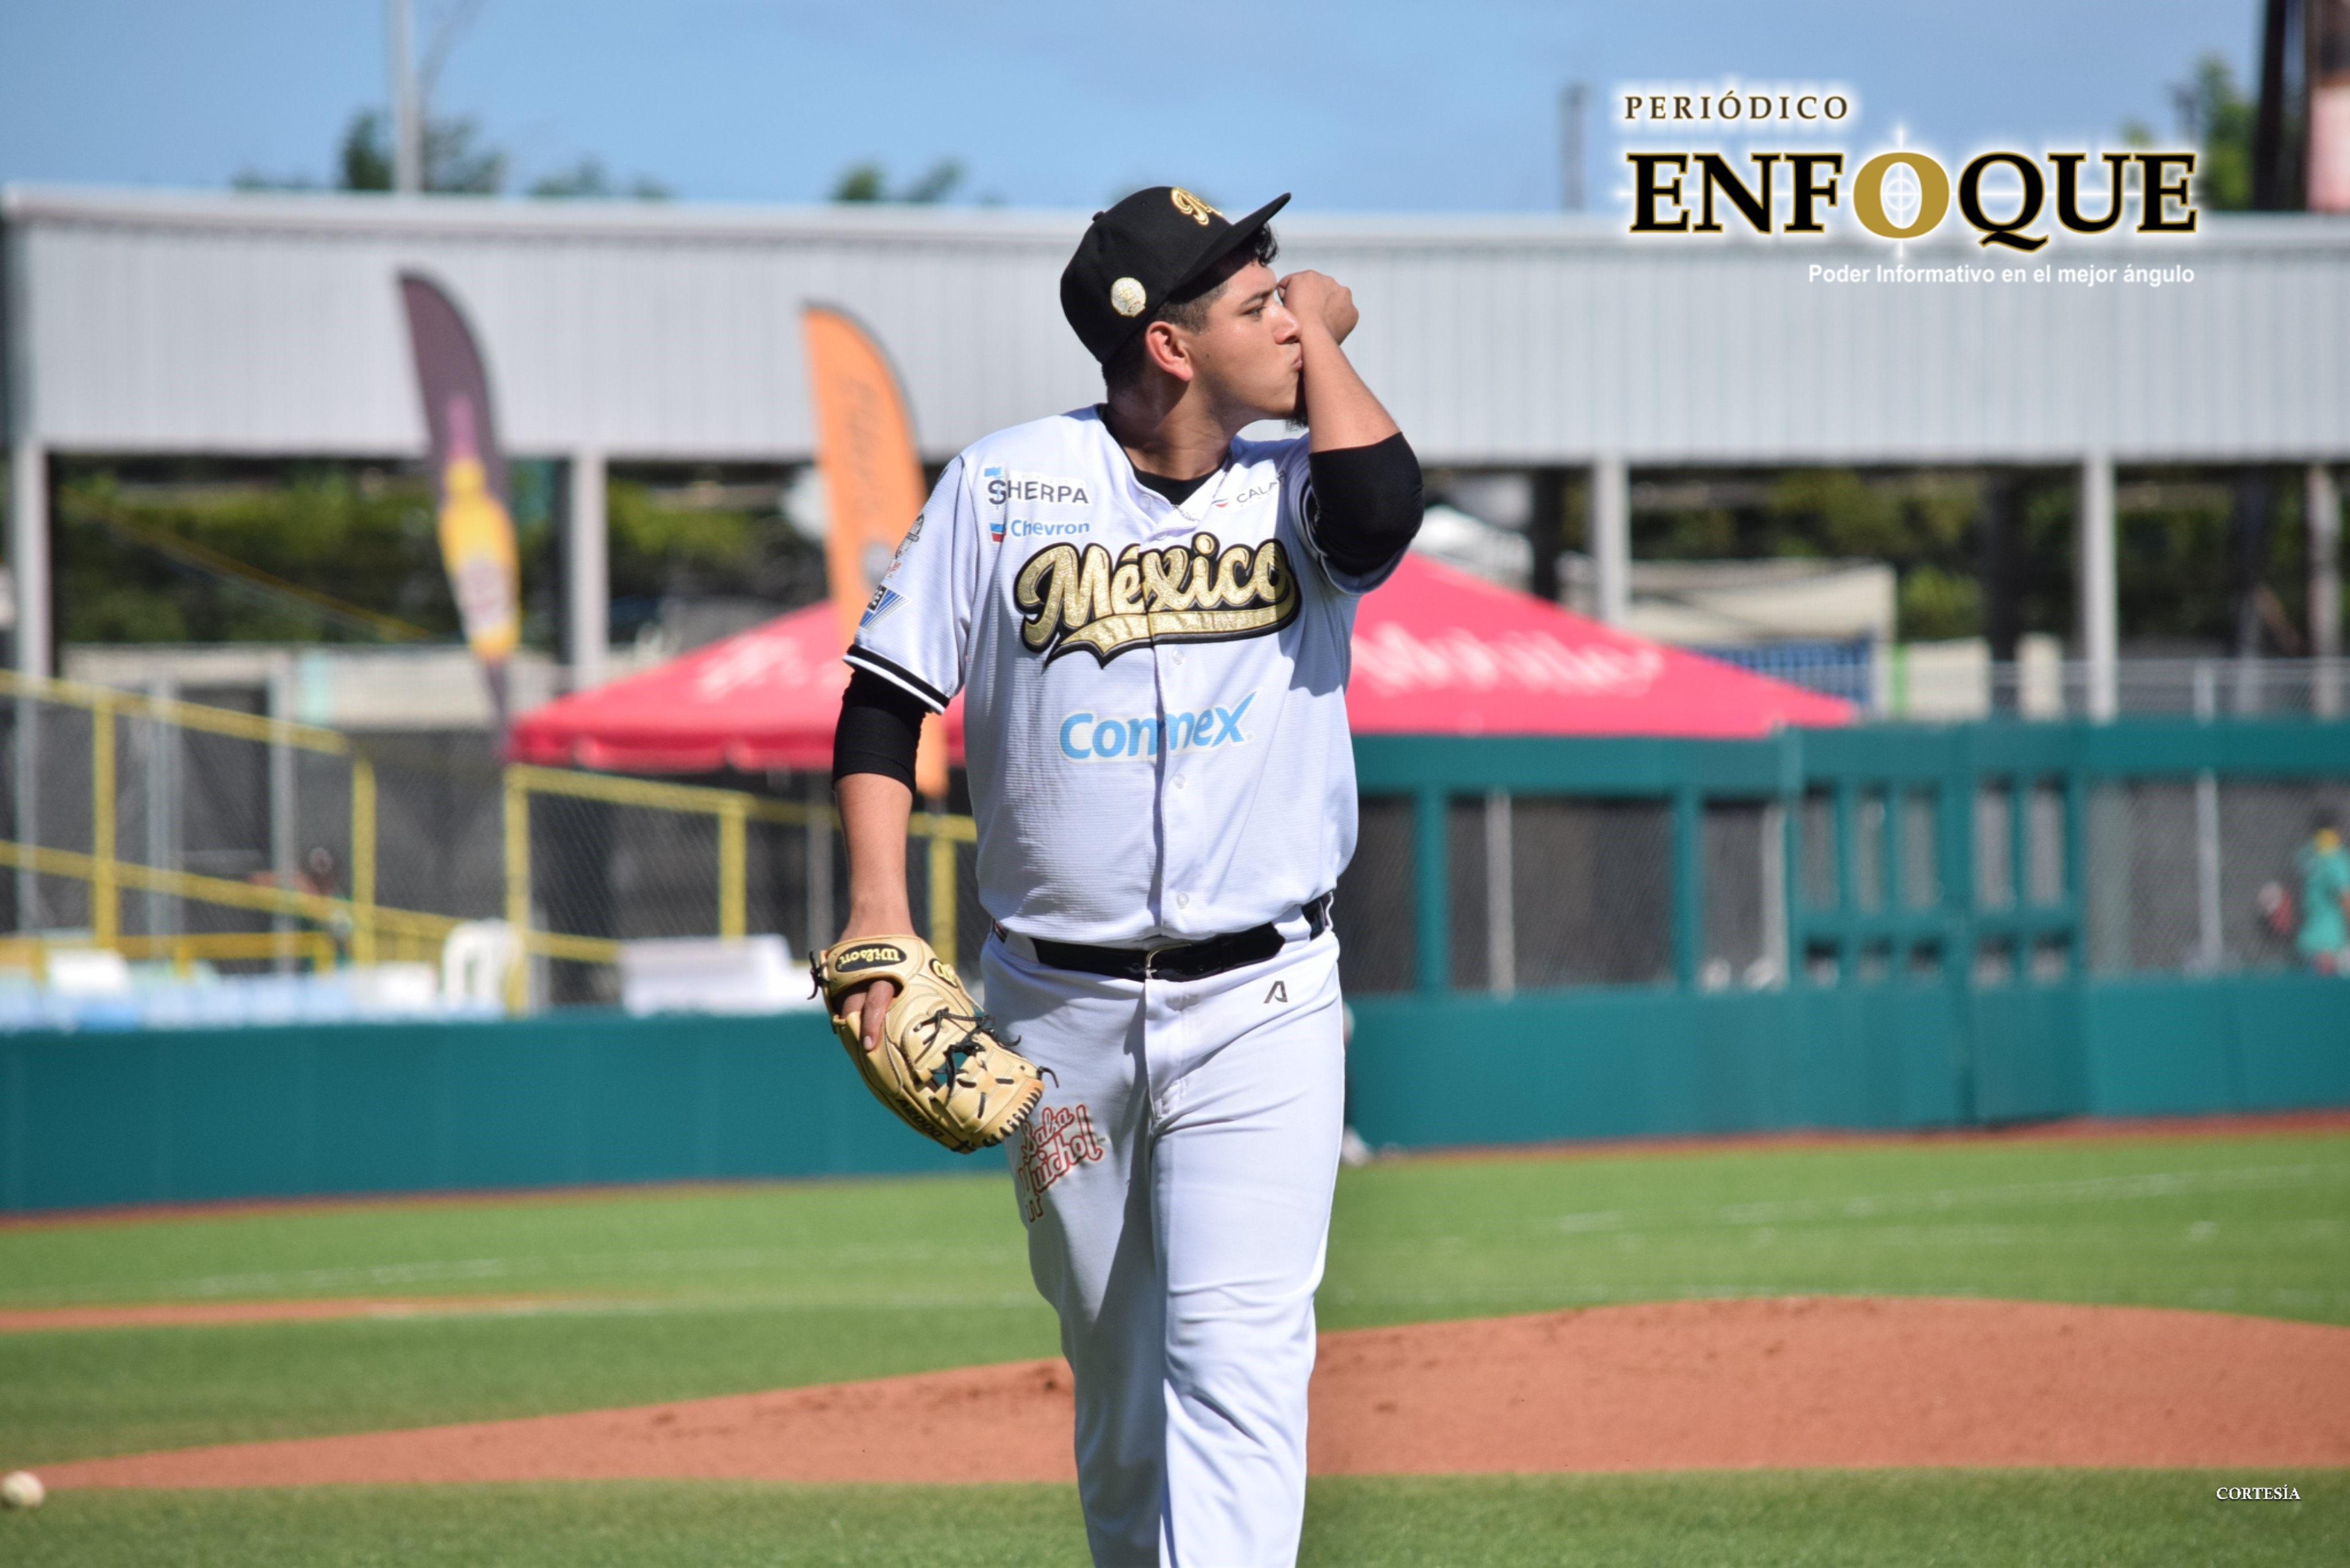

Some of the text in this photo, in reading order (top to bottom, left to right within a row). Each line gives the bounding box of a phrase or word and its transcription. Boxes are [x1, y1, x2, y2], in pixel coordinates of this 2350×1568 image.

[987, 479, 1090, 505] SHERPA
[1010, 519, 1090, 537] Chevron
[1014, 531, 1301, 660] México
[840, 947, 901, 966] Wilson
